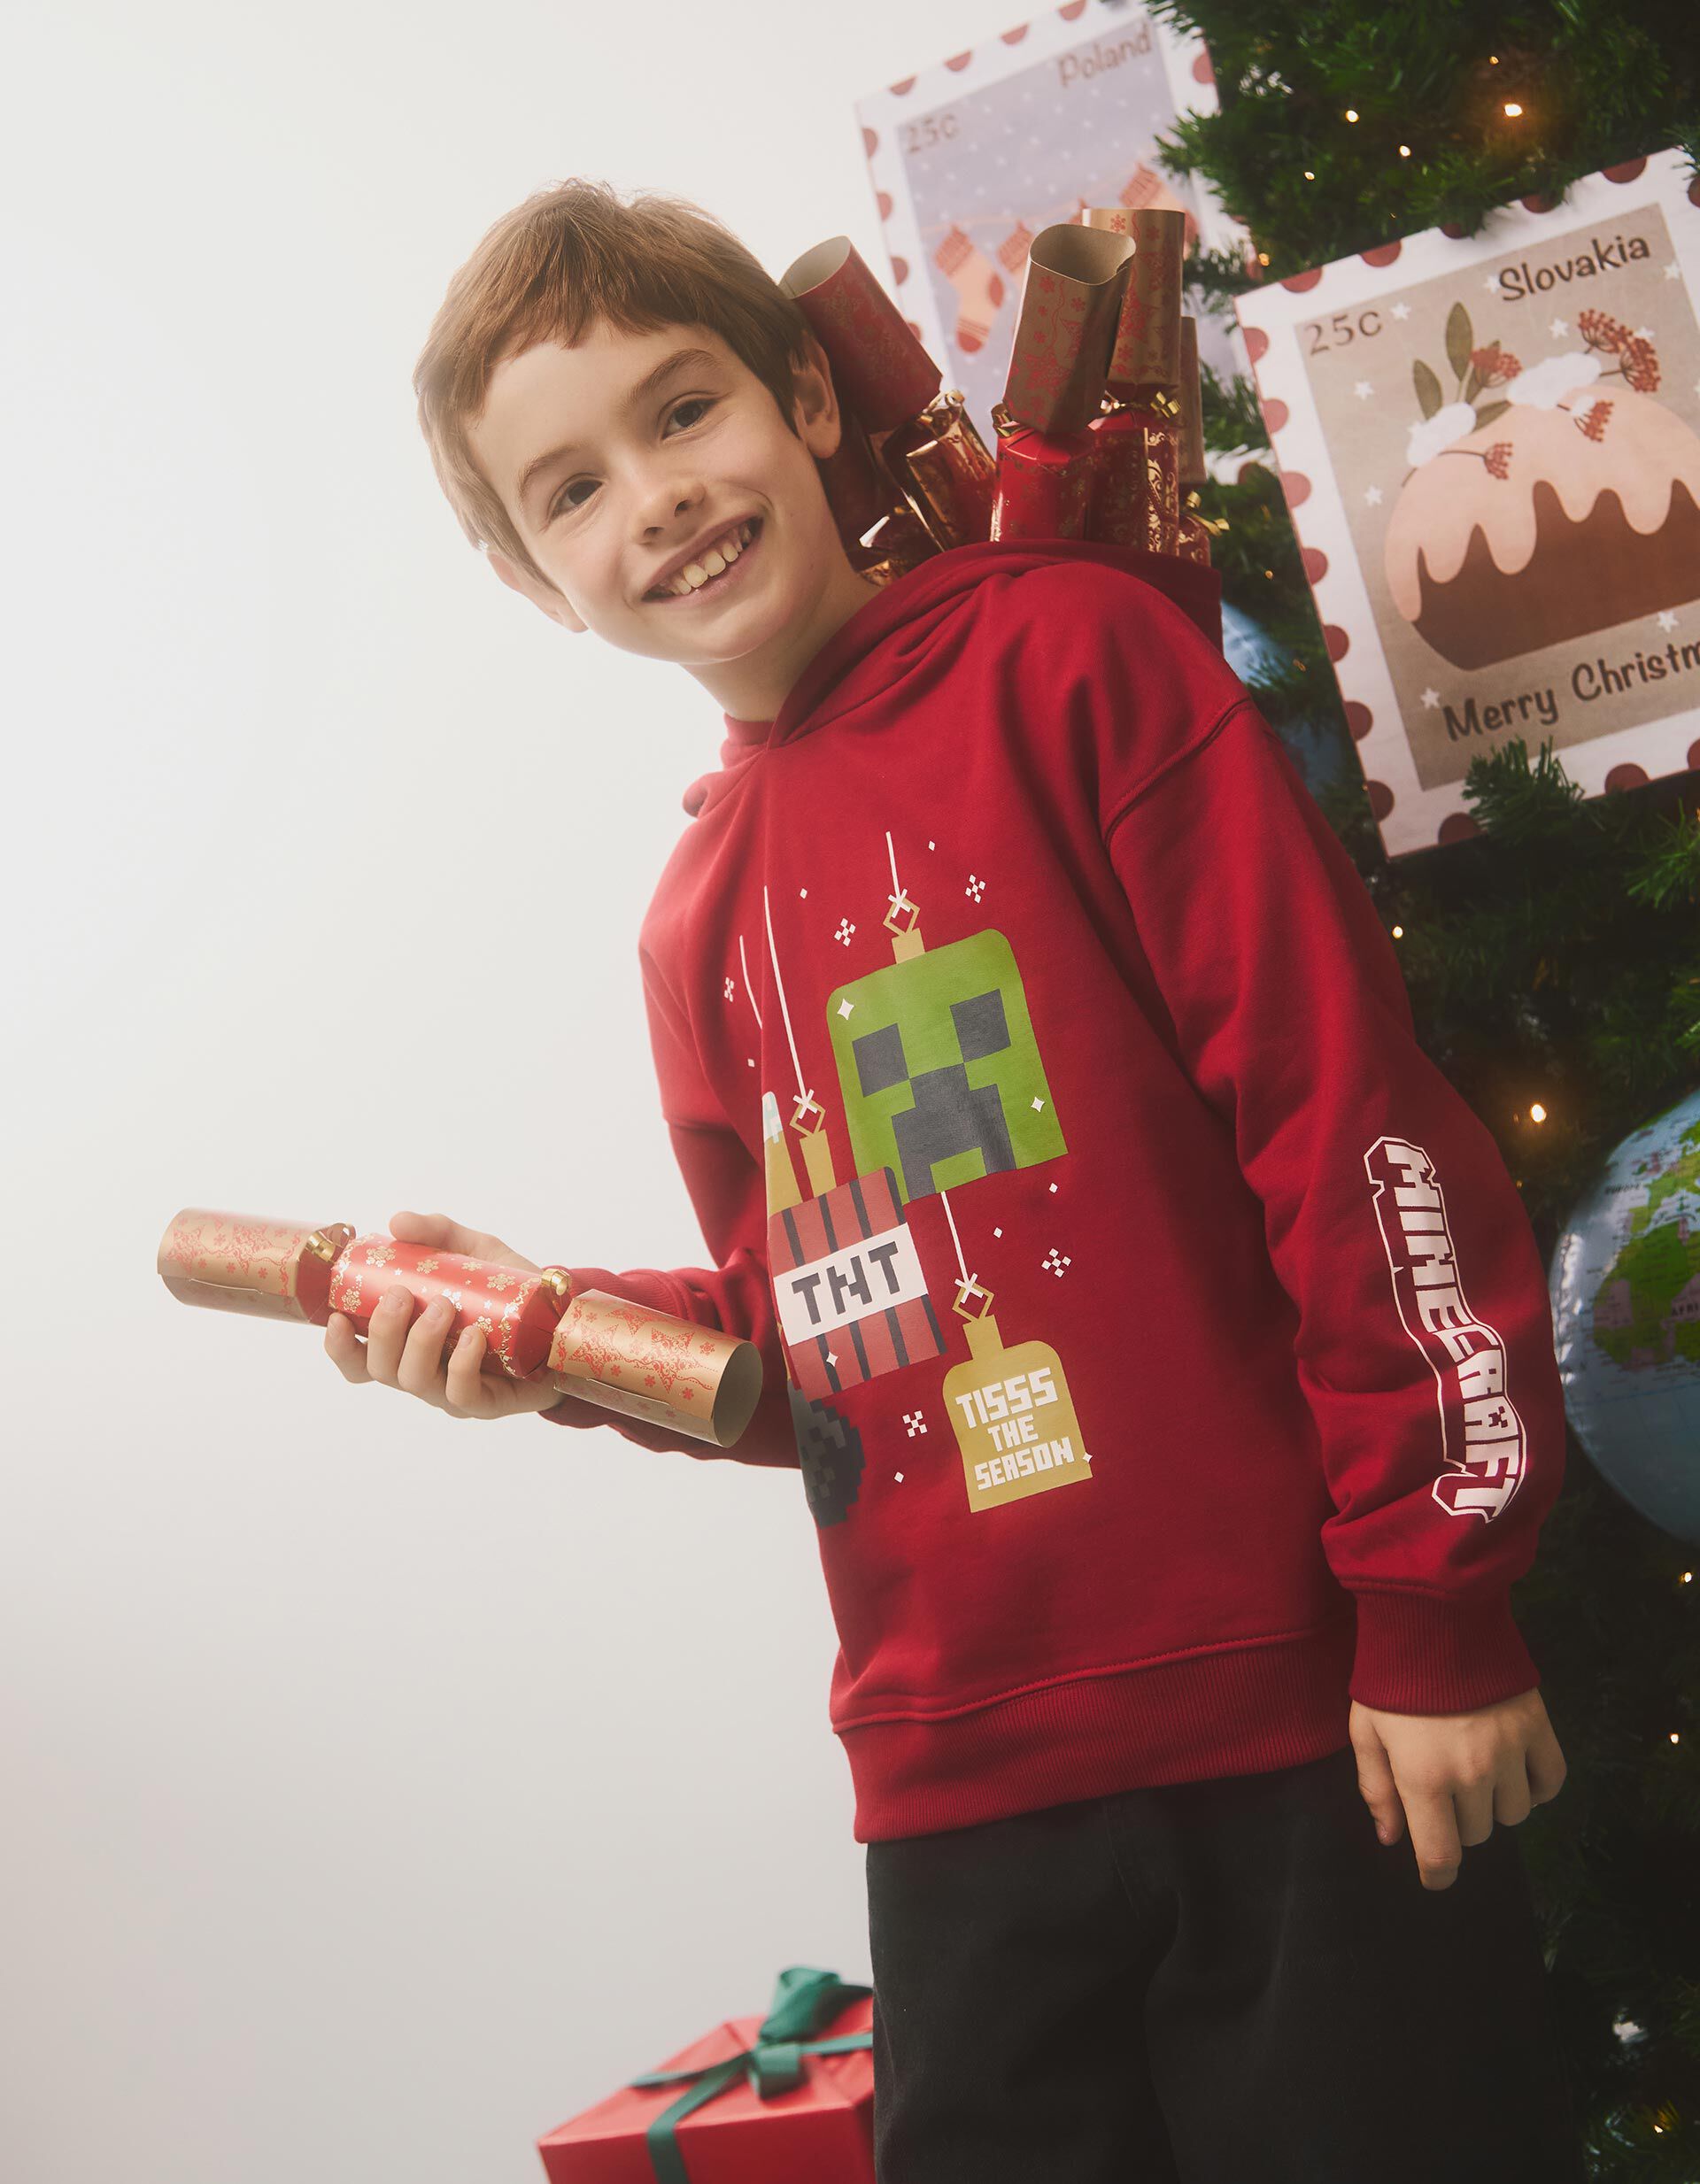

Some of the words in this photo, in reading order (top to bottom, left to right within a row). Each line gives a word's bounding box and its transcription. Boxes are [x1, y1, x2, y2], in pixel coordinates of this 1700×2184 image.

[1058, 21, 1152, 87] Poland
[1498, 235, 1651, 301] Slovakia
[1442, 689, 1558, 742] Merry
[791, 1241, 899, 1325] TNT
[1384, 1143, 1519, 1517] MINECRAFT
[955, 1367, 1058, 1429] TISSS
[974, 1437, 1075, 1491] SEASON
[987, 1415, 1039, 1452] THE
